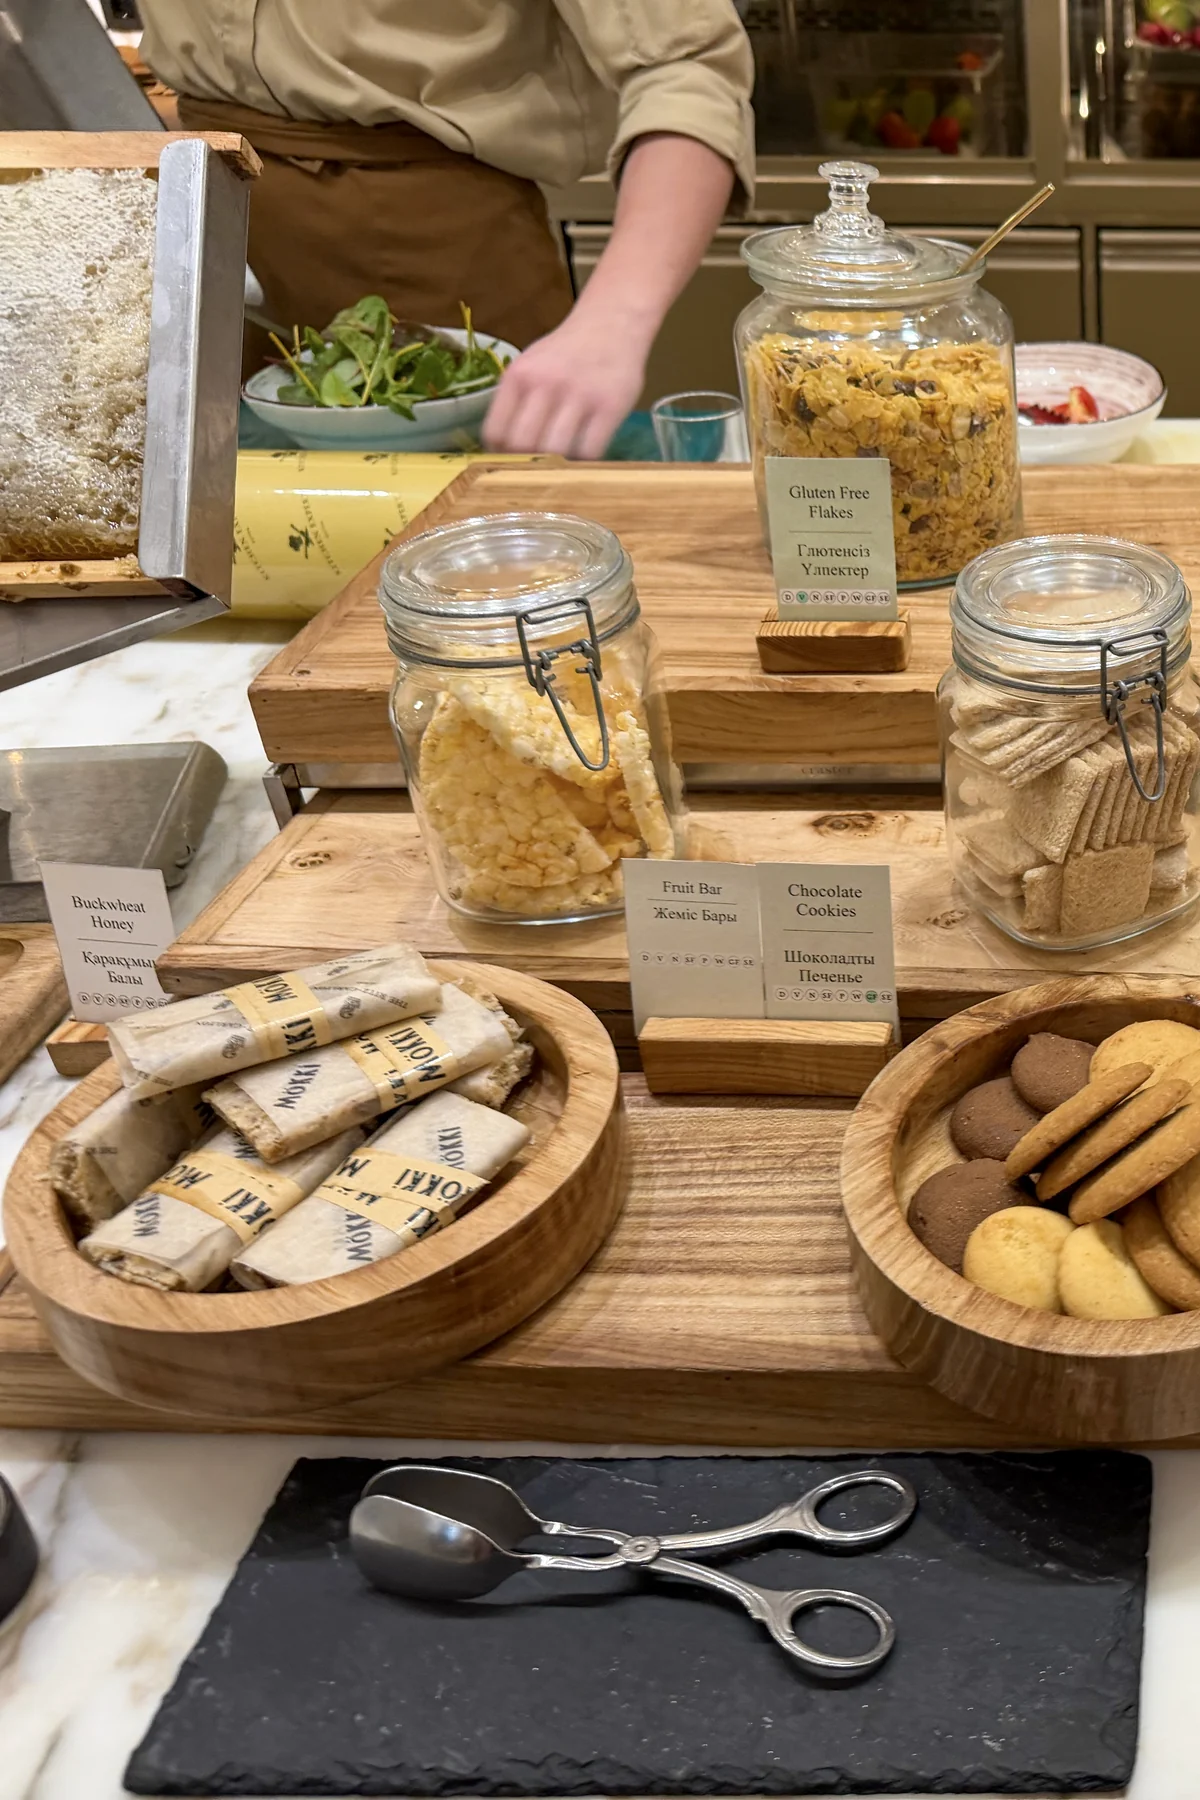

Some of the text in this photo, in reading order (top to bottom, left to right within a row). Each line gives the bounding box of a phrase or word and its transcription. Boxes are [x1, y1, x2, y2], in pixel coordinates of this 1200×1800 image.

[788, 485, 870, 500] Gluten Free
[809, 505, 854, 519] Flakes
[797, 544, 871, 558] Глютенсіз
[801, 563, 870, 579] Үлпектер
[662, 880, 723, 896] Fruit Bar
[787, 883, 863, 899] Chocolate
[71, 895, 146, 913] Buckwheat
[796, 903, 857, 917] Cookies
[91, 915, 134, 933] Honey
[653, 907, 738, 925] Жеміс Бары
[784, 950, 875, 966] Шоколадты
[106, 970, 144, 986] Балы
[799, 969, 863, 983] Печенье
